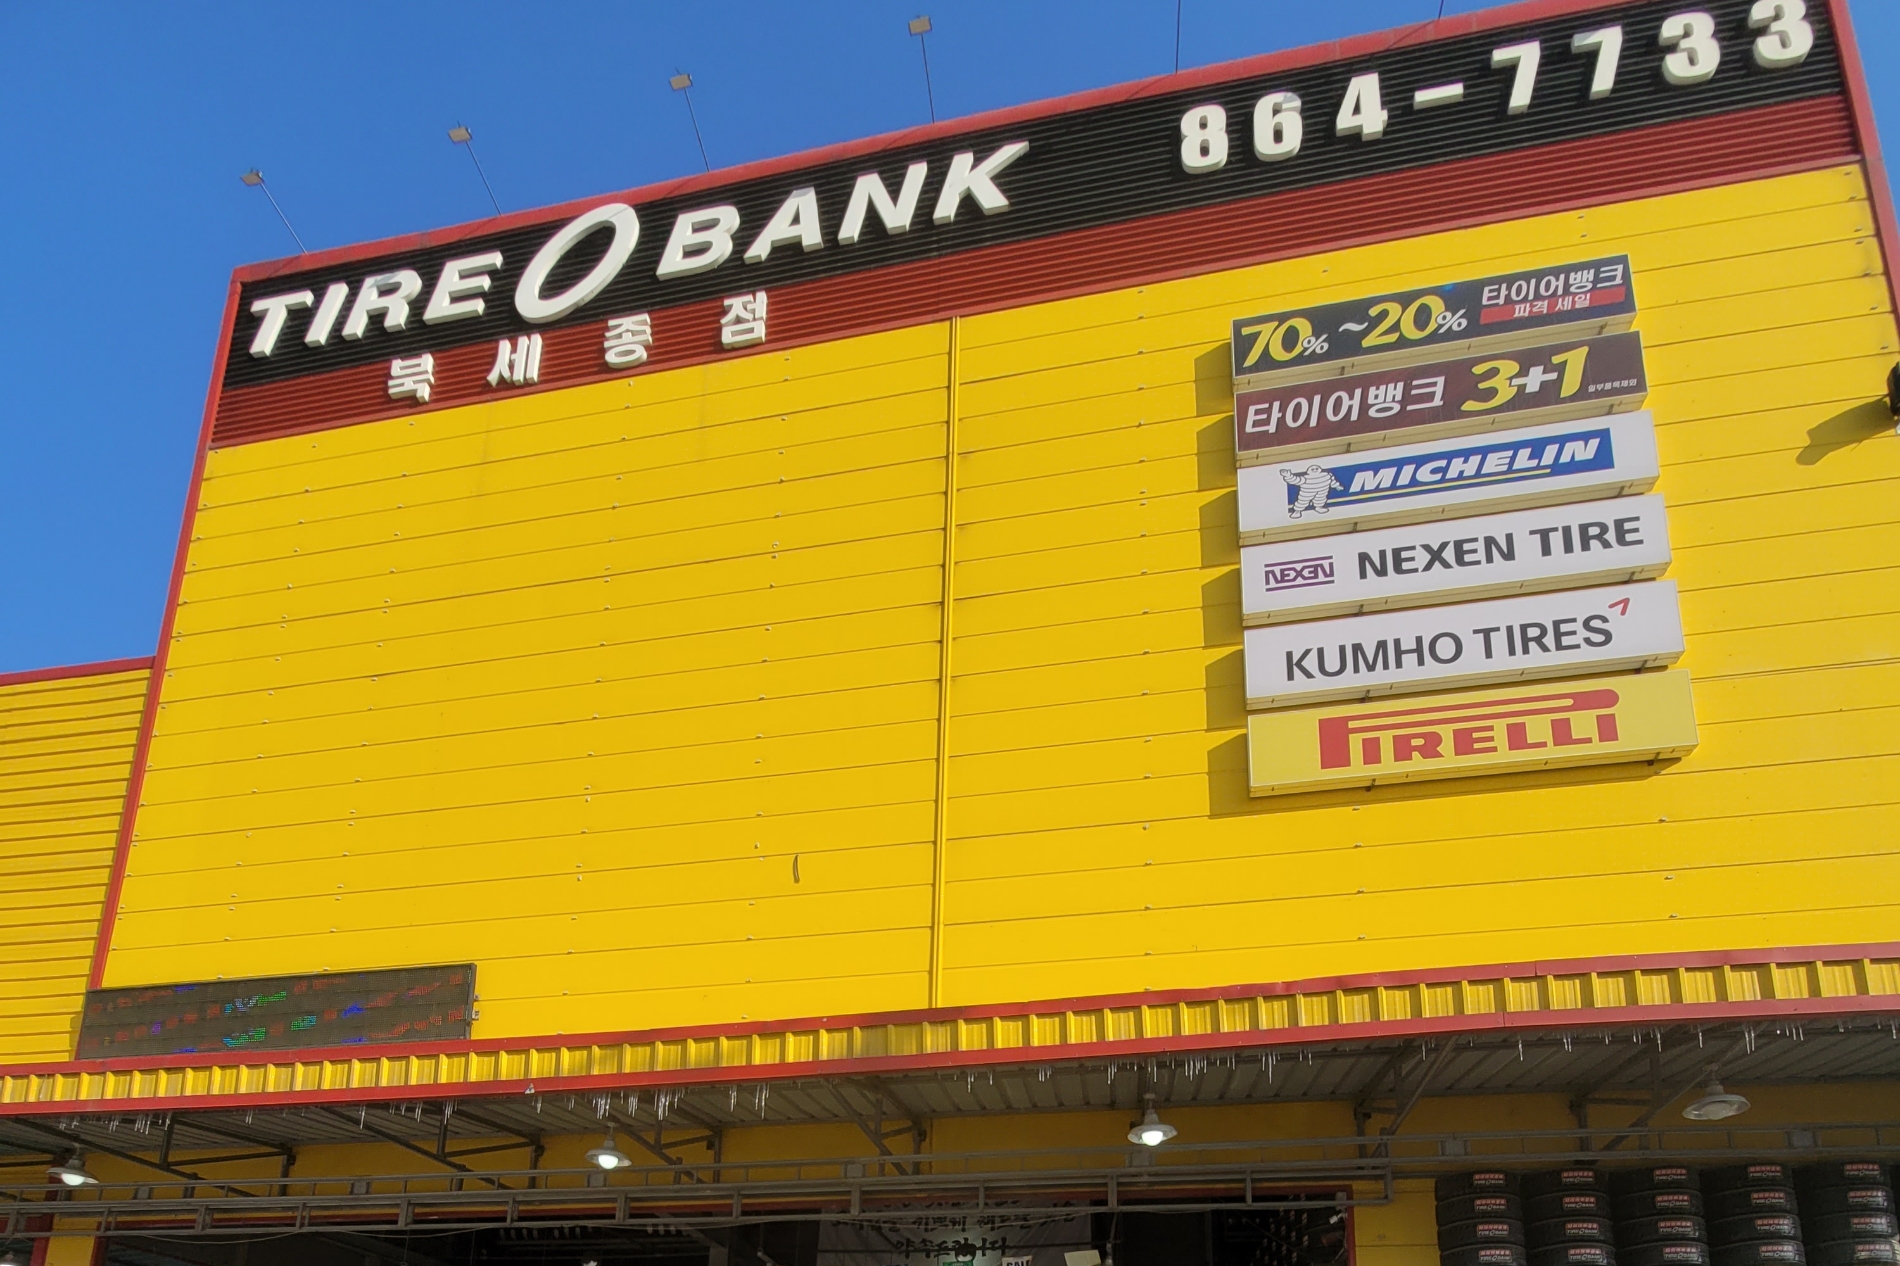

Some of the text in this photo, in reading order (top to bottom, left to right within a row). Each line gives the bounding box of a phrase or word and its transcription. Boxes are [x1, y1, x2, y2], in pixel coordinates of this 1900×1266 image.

[1180, 0, 1815, 175] 864-7733
[1481, 264, 1624, 306] 타이어뱅크
[1513, 293, 1591, 318] 파격 세일
[1241, 317, 1330, 369] 70%
[1244, 375, 1446, 434] 타이어뱅크
[1460, 345, 1590, 412] 3+1
[1349, 437, 1601, 494] MICHELIN
[1357, 532, 1517, 581] NEXEN
[1529, 516, 1645, 558] TIRE
[1285, 614, 1613, 682] KUMHO TIRES
[1318, 688, 1621, 770] PIRELLI
